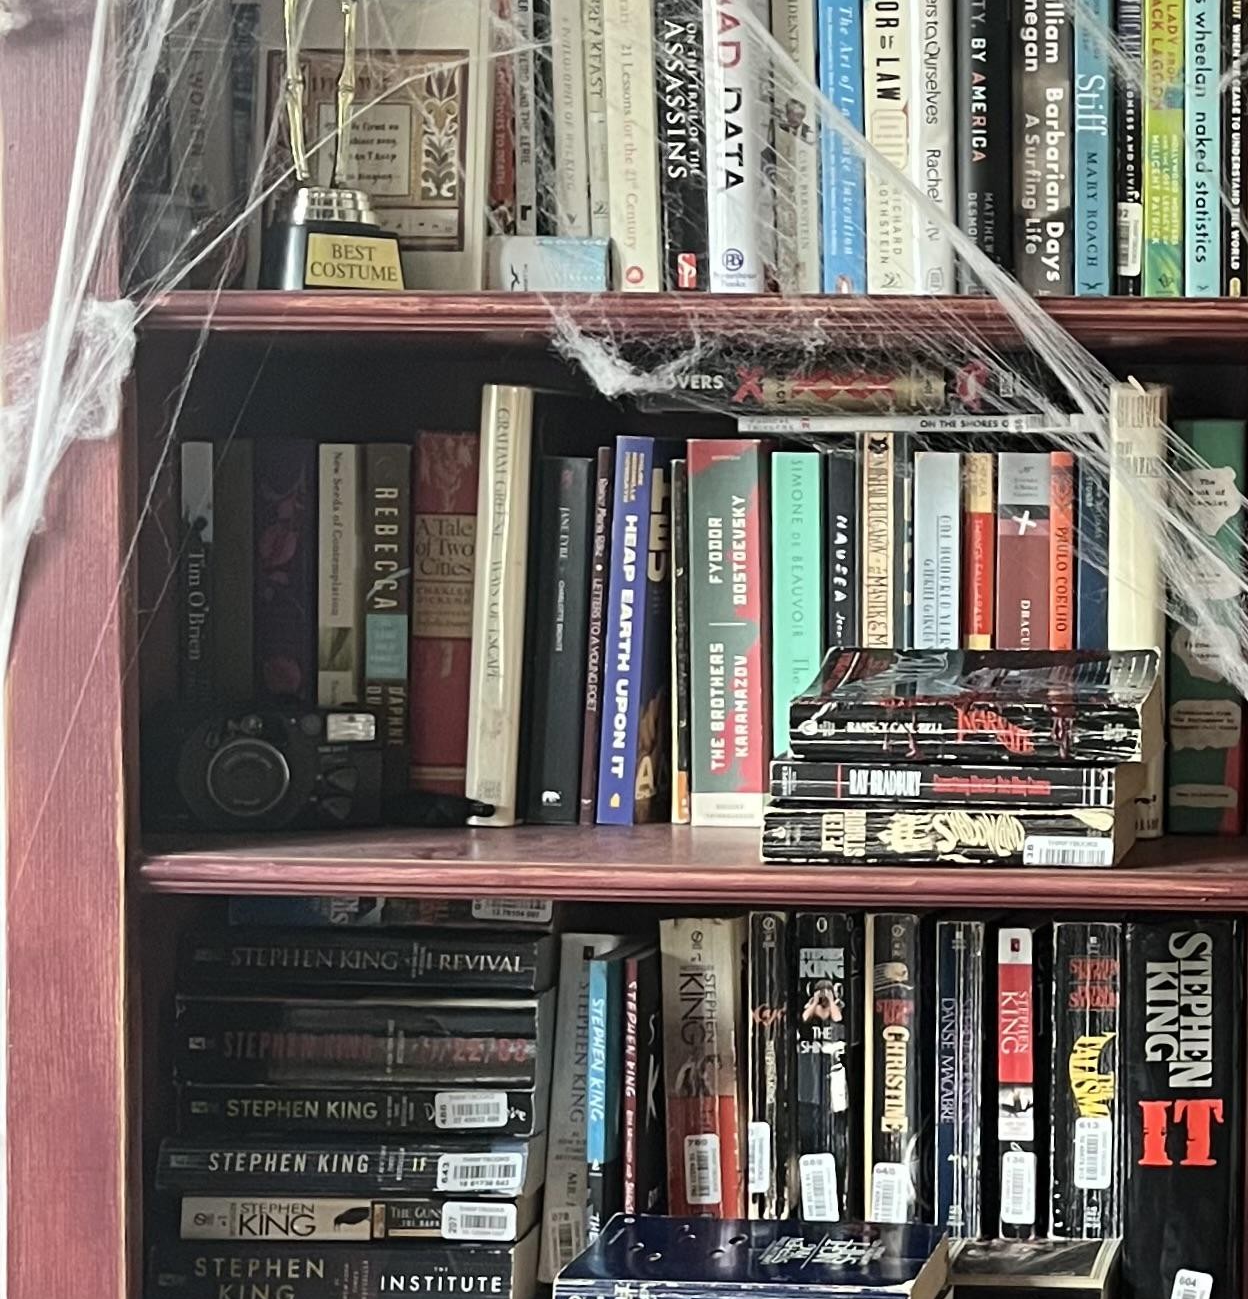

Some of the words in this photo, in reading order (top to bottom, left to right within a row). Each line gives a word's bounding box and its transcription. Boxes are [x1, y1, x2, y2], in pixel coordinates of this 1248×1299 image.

[880, 35, 893, 47] OF
[1195, 13, 1207, 98] wheelan
[875, 57, 900, 101] LAW
[1077, 75, 1107, 134] Stiff
[1024, 114, 1037, 127] A
[1045, 88, 1065, 212] Barbarian
[1196, 112, 1207, 174] naked
[1023, 133, 1040, 211] Surfing
[331, 243, 376, 262] BEST
[1024, 218, 1041, 255] Life
[1045, 221, 1066, 282] Days
[1196, 181, 1207, 263] statistics
[311, 261, 398, 282] COSTUME
[374, 488, 398, 609] REBECCA
[708, 516, 723, 585] FYODOR
[733, 496, 747, 606] DOSTOEVSKY
[710, 643, 725, 732] BROTHERS
[735, 655, 748, 758] KARAMAZOV
[710, 737, 724, 771] THE
[1145, 961, 1178, 1062] KING
[1169, 931, 1213, 1088] STEPHEN
[1139, 1099, 1224, 1166] IT
[380, 1276, 501, 1293] INSTITUTE
